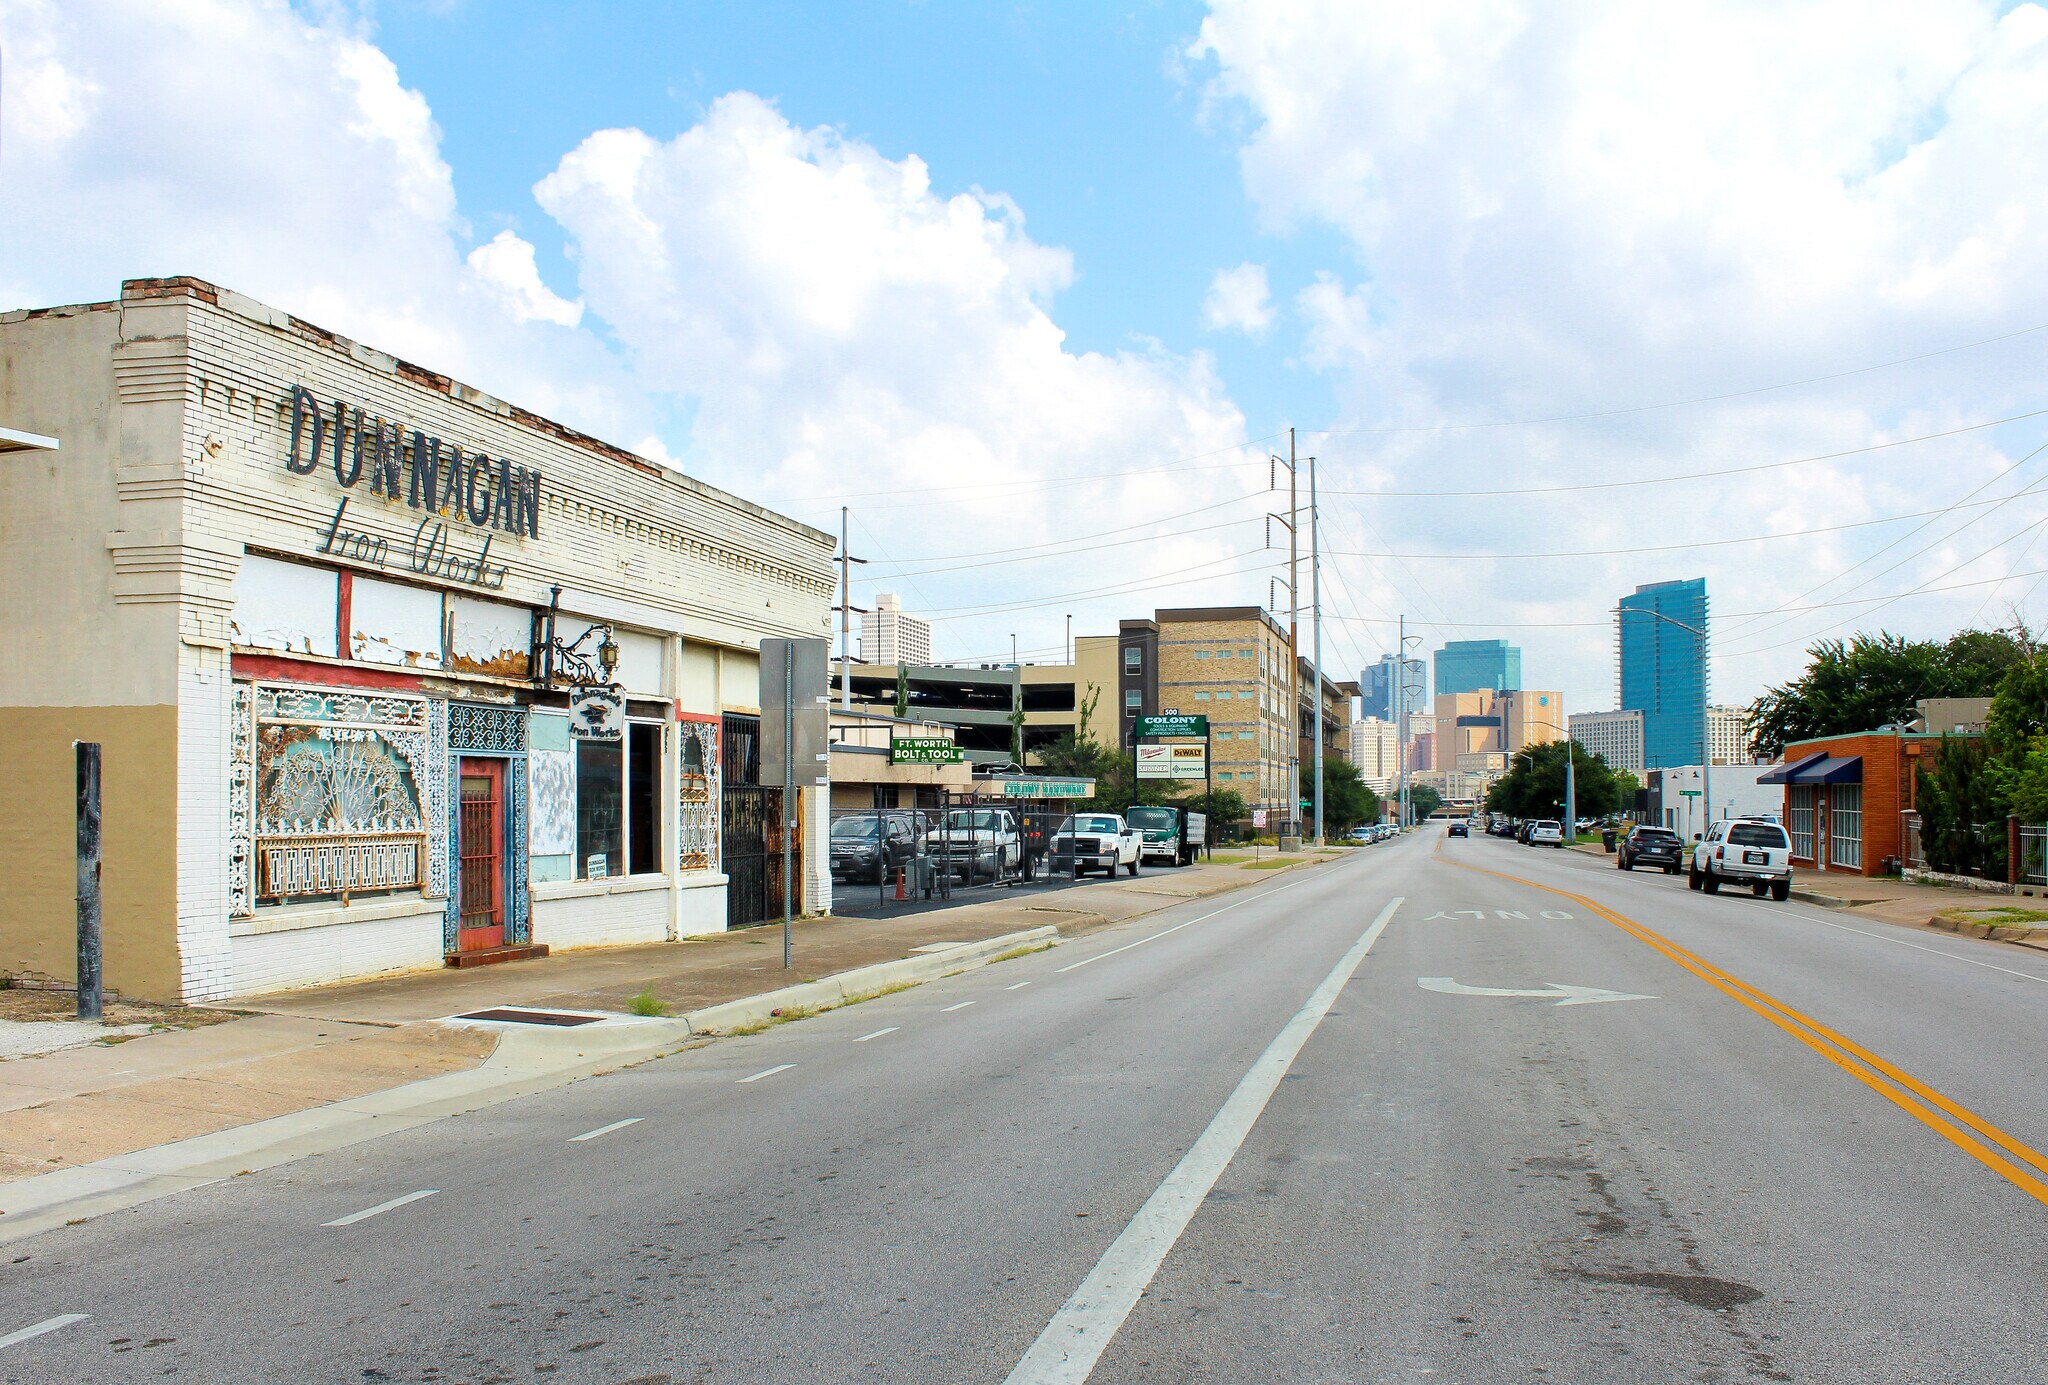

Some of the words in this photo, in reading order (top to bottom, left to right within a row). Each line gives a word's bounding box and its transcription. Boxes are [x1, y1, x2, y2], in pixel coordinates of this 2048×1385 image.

[286, 383, 542, 541] DUNNAGAN
[324, 495, 389, 571] Iron
[413, 515, 510, 591] Works
[1144, 716, 1197, 724] COLONY
[569, 722, 589, 737] Iron
[591, 725, 621, 738] Works
[899, 740, 912, 748] FT.
[914, 740, 949, 748] WORTH
[894, 749, 921, 759] BOLT
[927, 749, 956, 759] TOOL
[1004, 781, 1040, 797] COLONY
[1042, 782, 1087, 797] HARDWARE
[1423, 910, 1575, 921] ONLY
